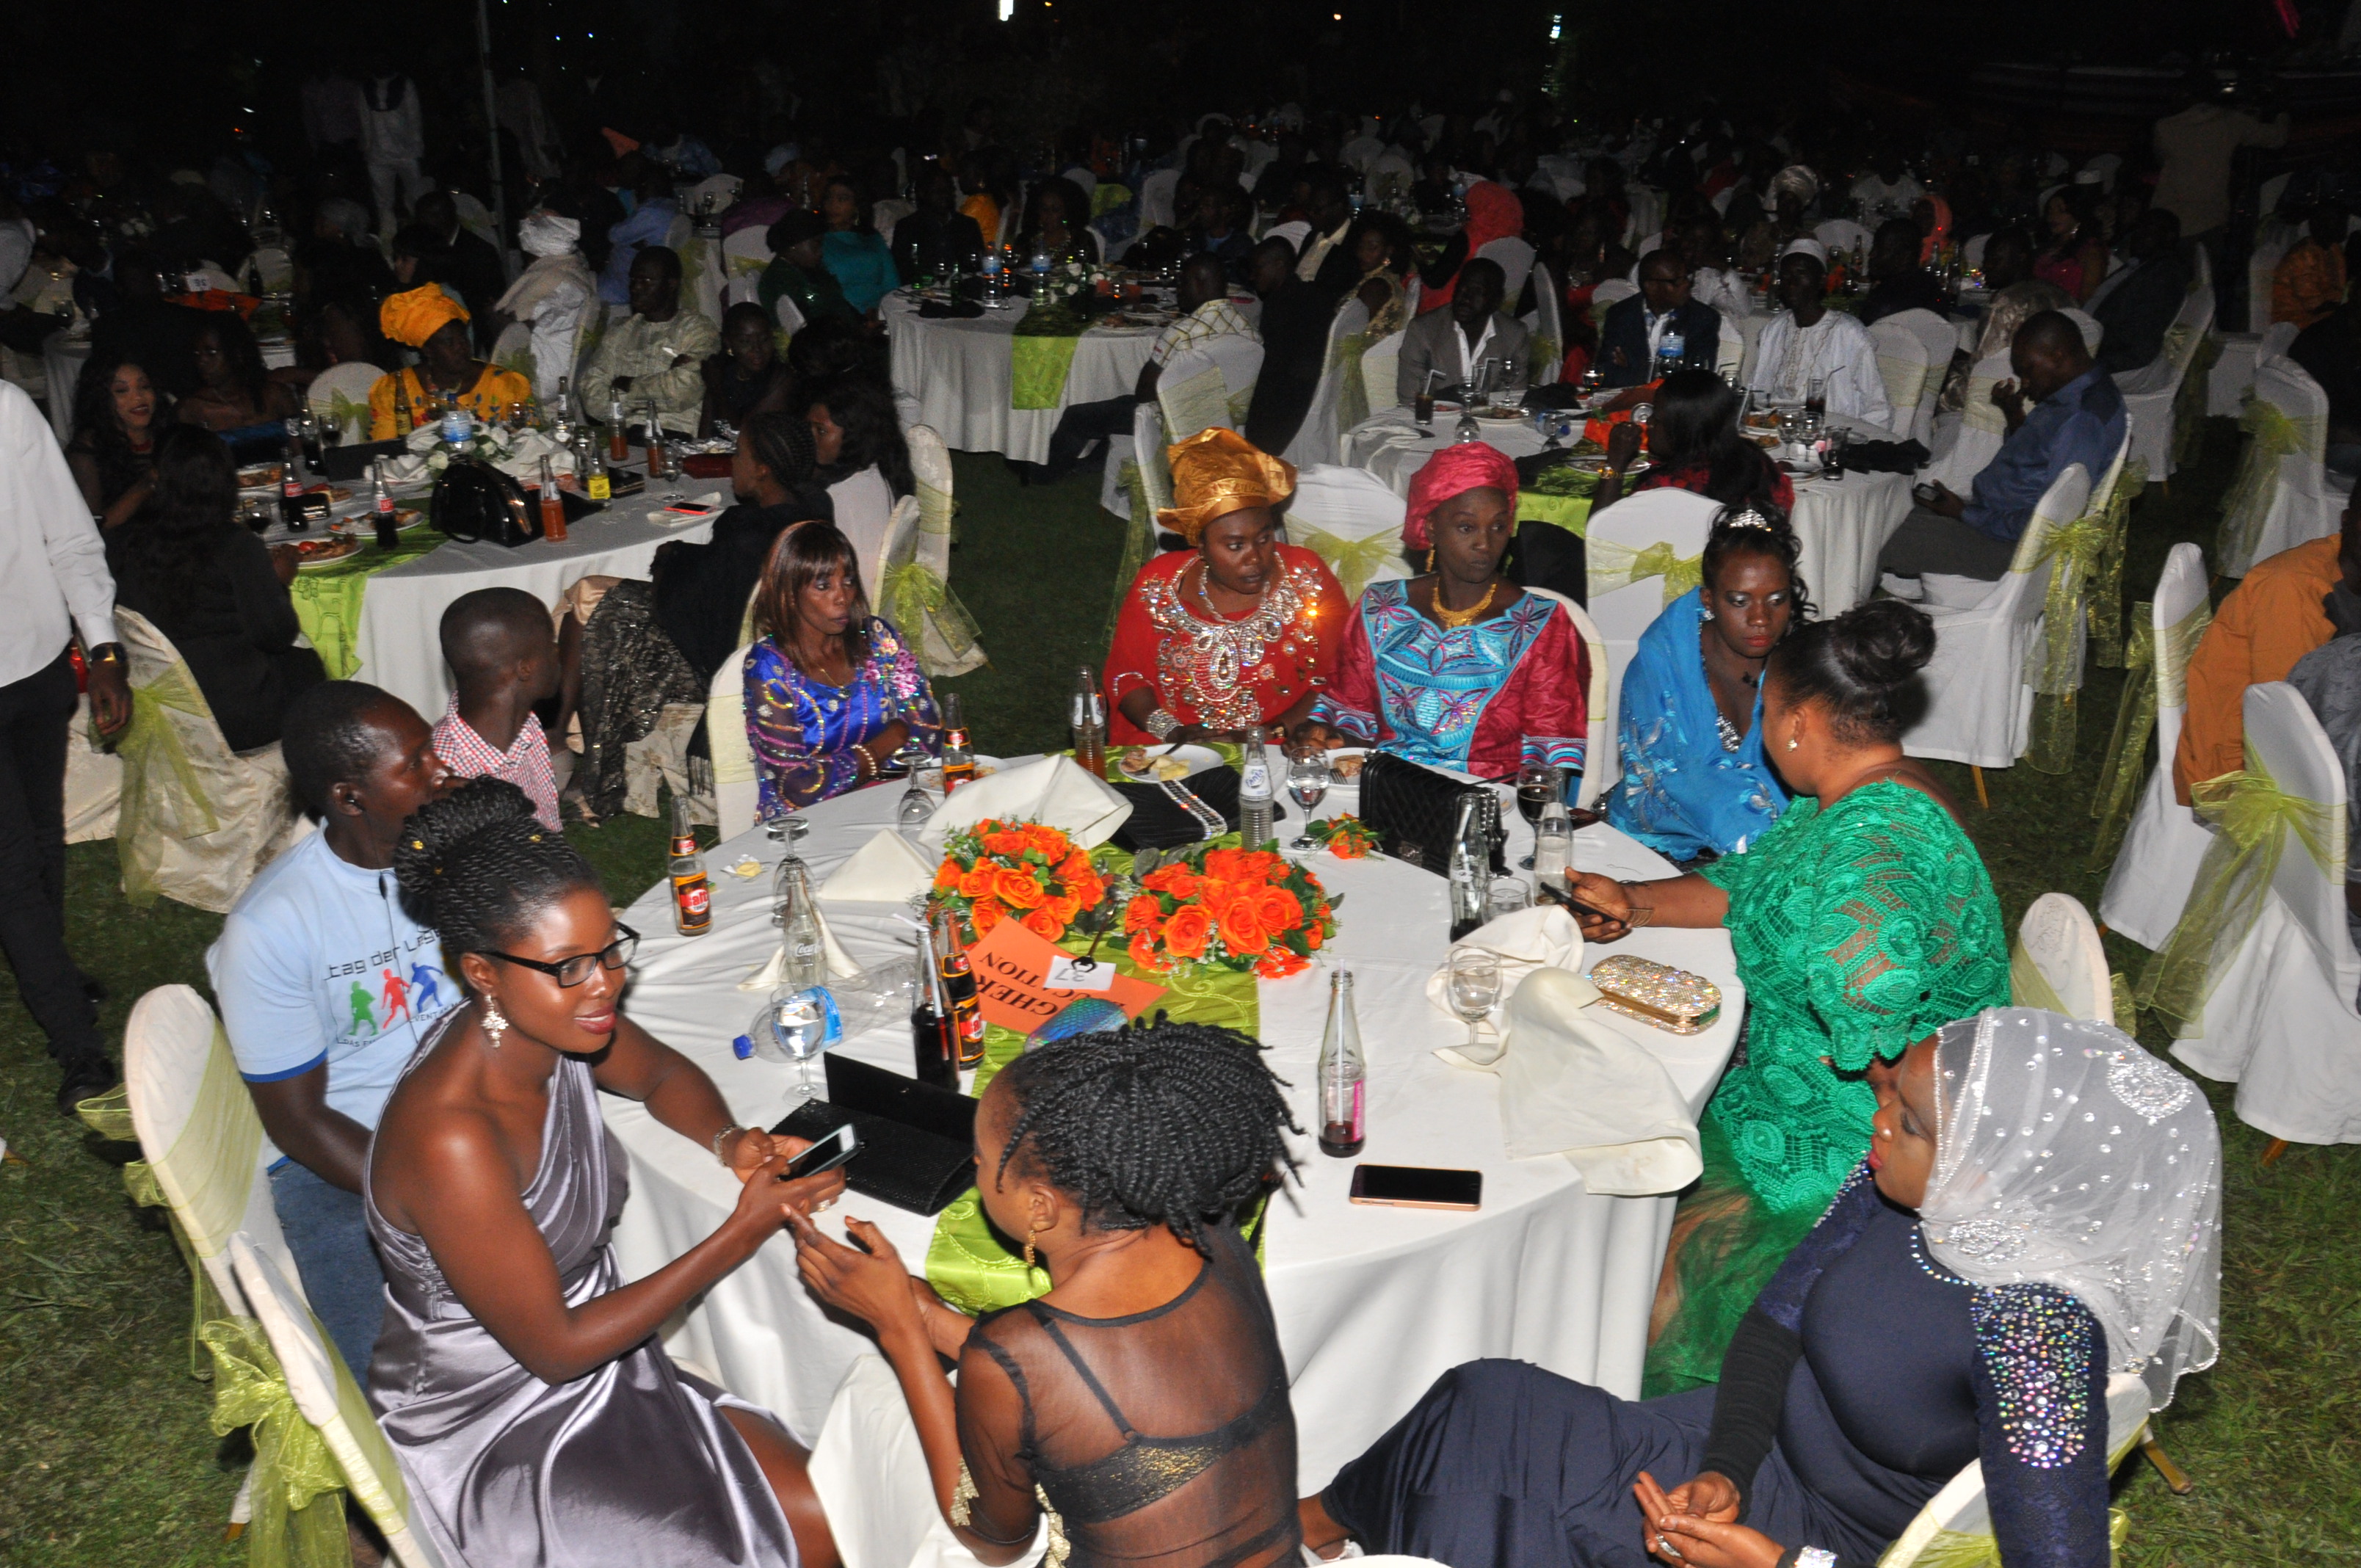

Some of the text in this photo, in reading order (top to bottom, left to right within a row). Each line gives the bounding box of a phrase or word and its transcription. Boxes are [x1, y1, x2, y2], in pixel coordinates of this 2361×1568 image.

[325, 959, 367, 980] tag
[370, 946, 400, 967] der
[1055, 968, 1085, 982] 37
[975, 974, 1058, 1017] GHER
